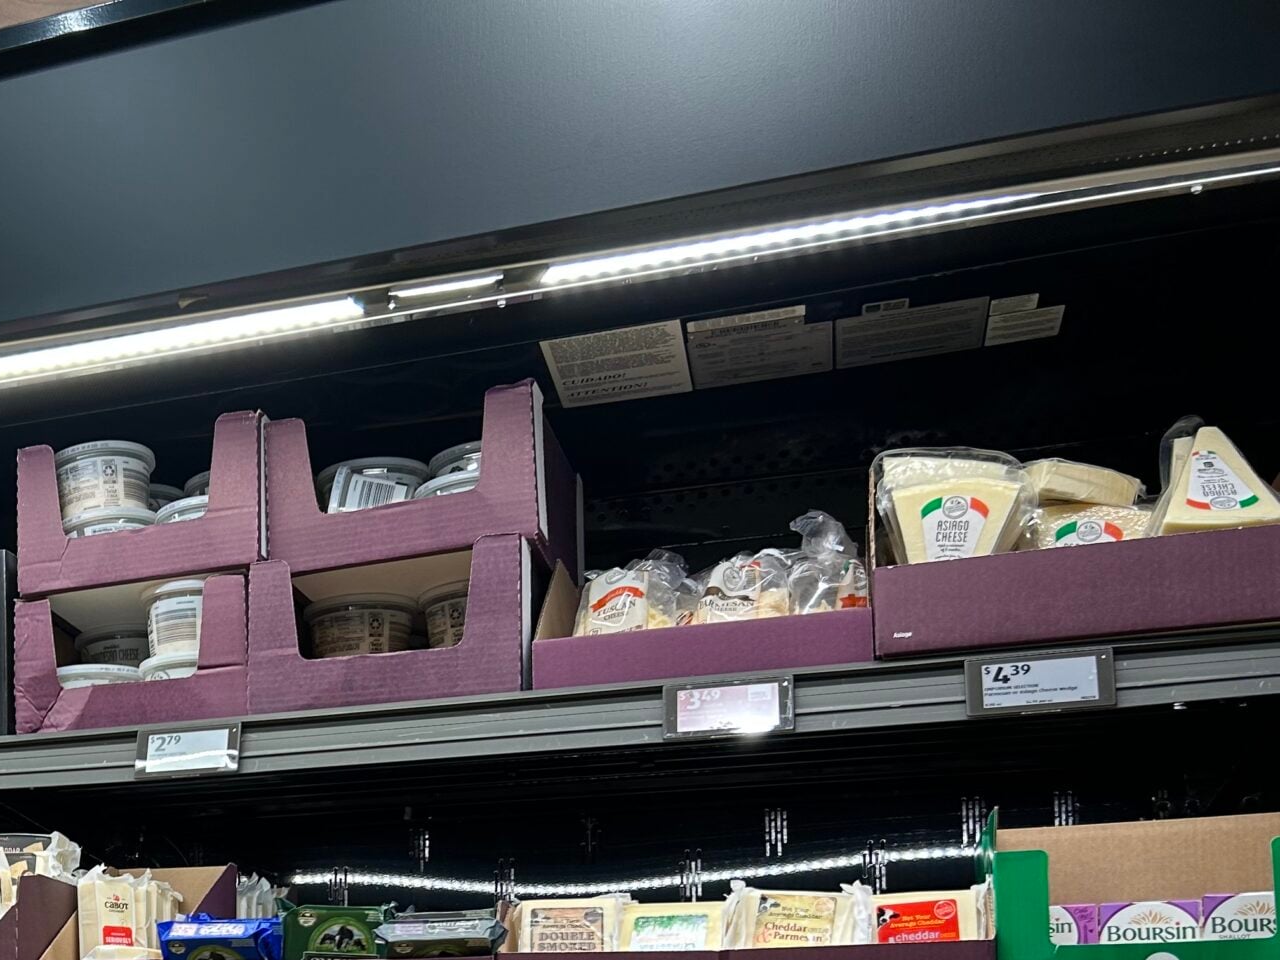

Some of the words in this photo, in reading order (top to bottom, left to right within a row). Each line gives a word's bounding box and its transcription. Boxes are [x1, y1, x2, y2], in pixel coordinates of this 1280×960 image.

[936, 521, 970, 531] ASIAGO
[935, 531, 968, 543] CHEESE
[764, 921, 808, 933] Cheddar
[1211, 916, 1277, 939] Bours
[538, 931, 595, 942] DOUBLE
[773, 932, 823, 943] Parmesn
[896, 931, 940, 942] cheddar
[537, 942, 597, 952] SMOKED
